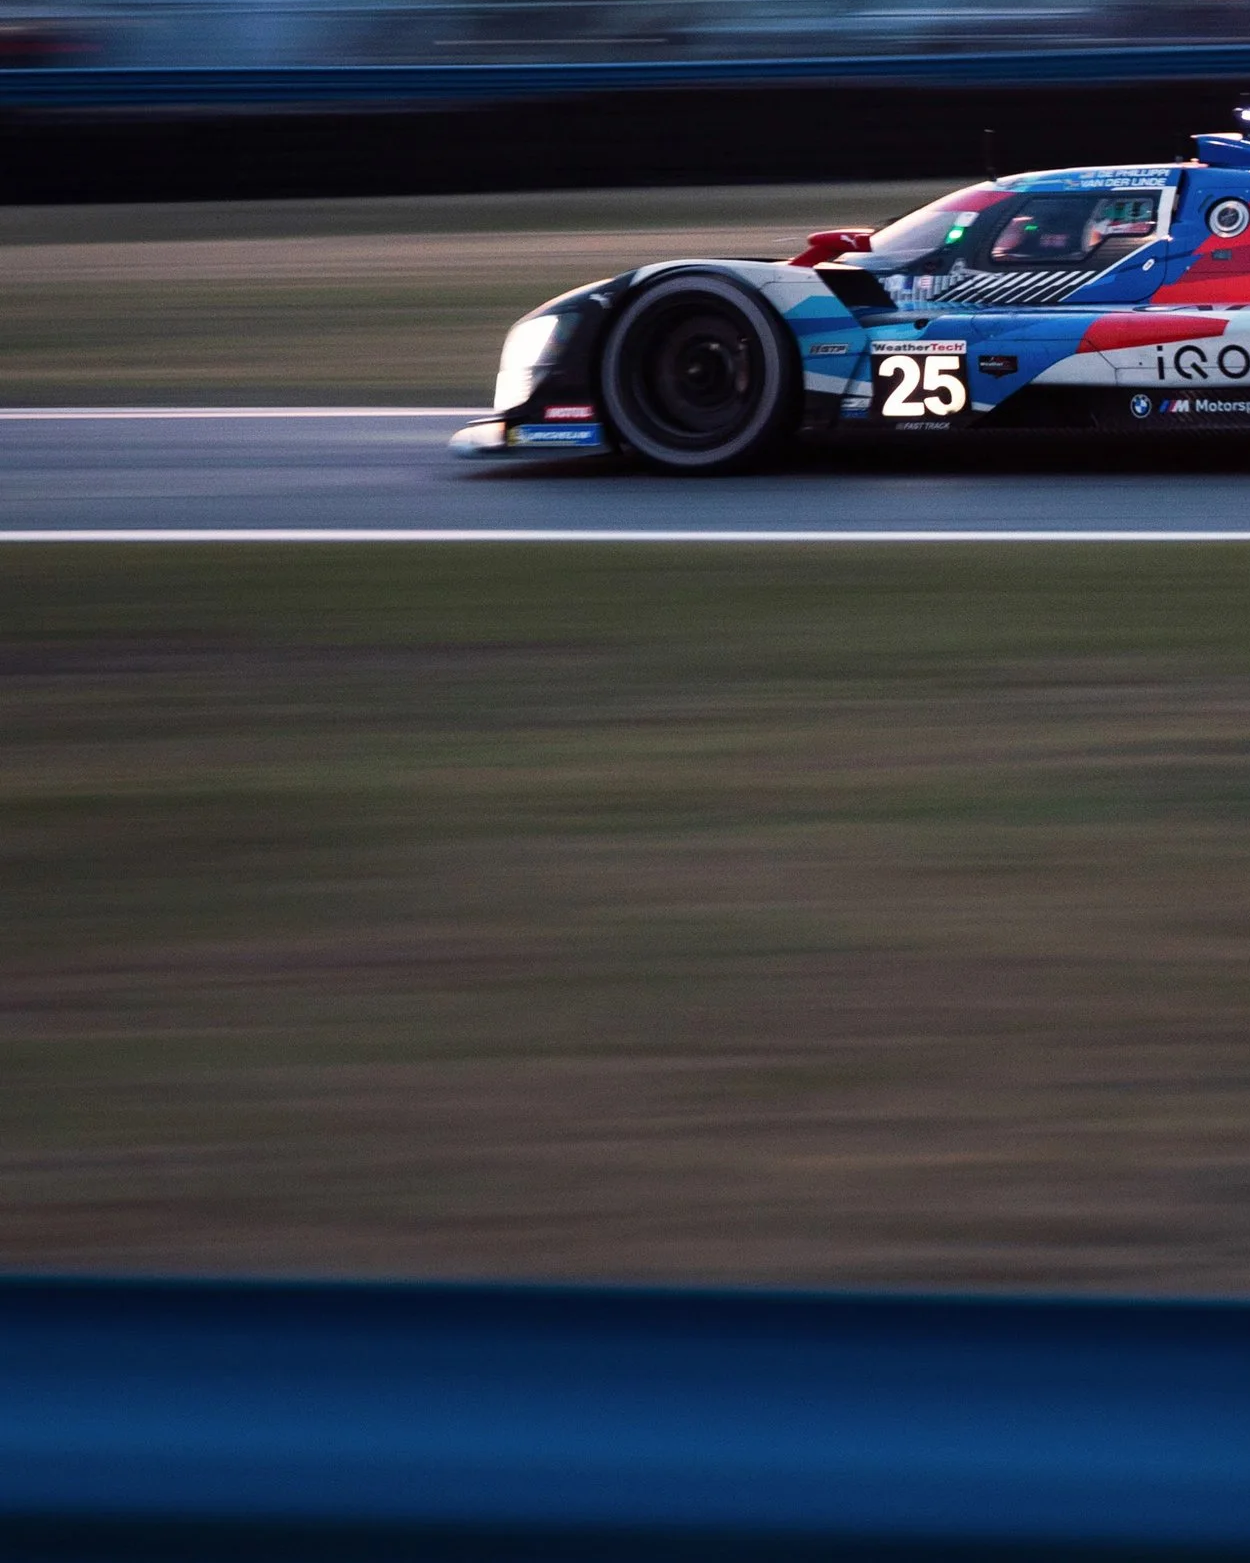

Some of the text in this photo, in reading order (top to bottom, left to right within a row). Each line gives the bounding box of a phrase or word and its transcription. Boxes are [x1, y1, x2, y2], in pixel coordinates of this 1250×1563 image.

[1080, 177, 1167, 188] VAN DER LINDE
[872, 342, 965, 352] WeatherTech
[878, 355, 966, 416] 25
[903, 421, 950, 430] FAST TRACK
